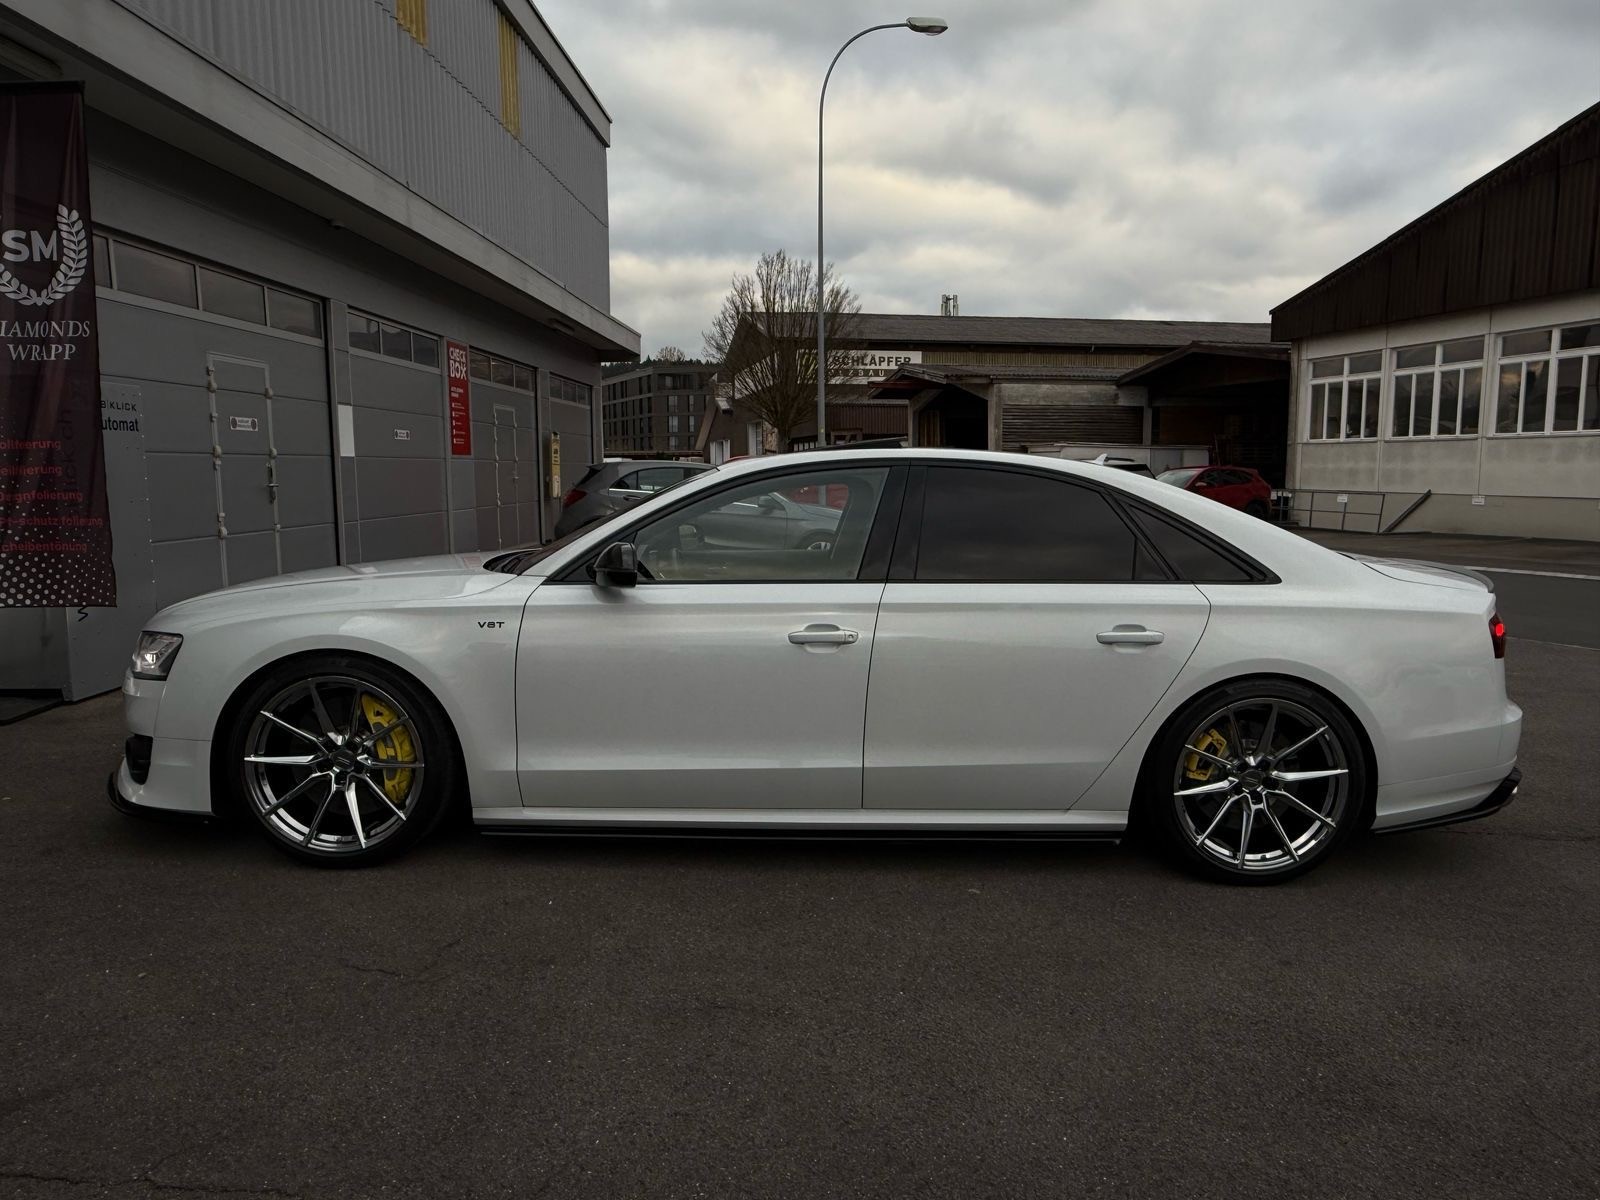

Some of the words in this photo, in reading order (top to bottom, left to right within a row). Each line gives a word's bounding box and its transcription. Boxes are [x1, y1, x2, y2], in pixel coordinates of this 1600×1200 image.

[1, 229, 58, 262] SM
[0, 320, 90, 338] IAMONDS
[7, 343, 77, 361] WRAPP
[448, 347, 467, 364] CHECK
[449, 360, 467, 381] BOX
[101, 416, 140, 433] utomat
[1, 541, 88, 553] cheibentönung
[478, 621, 505, 629] V8T
